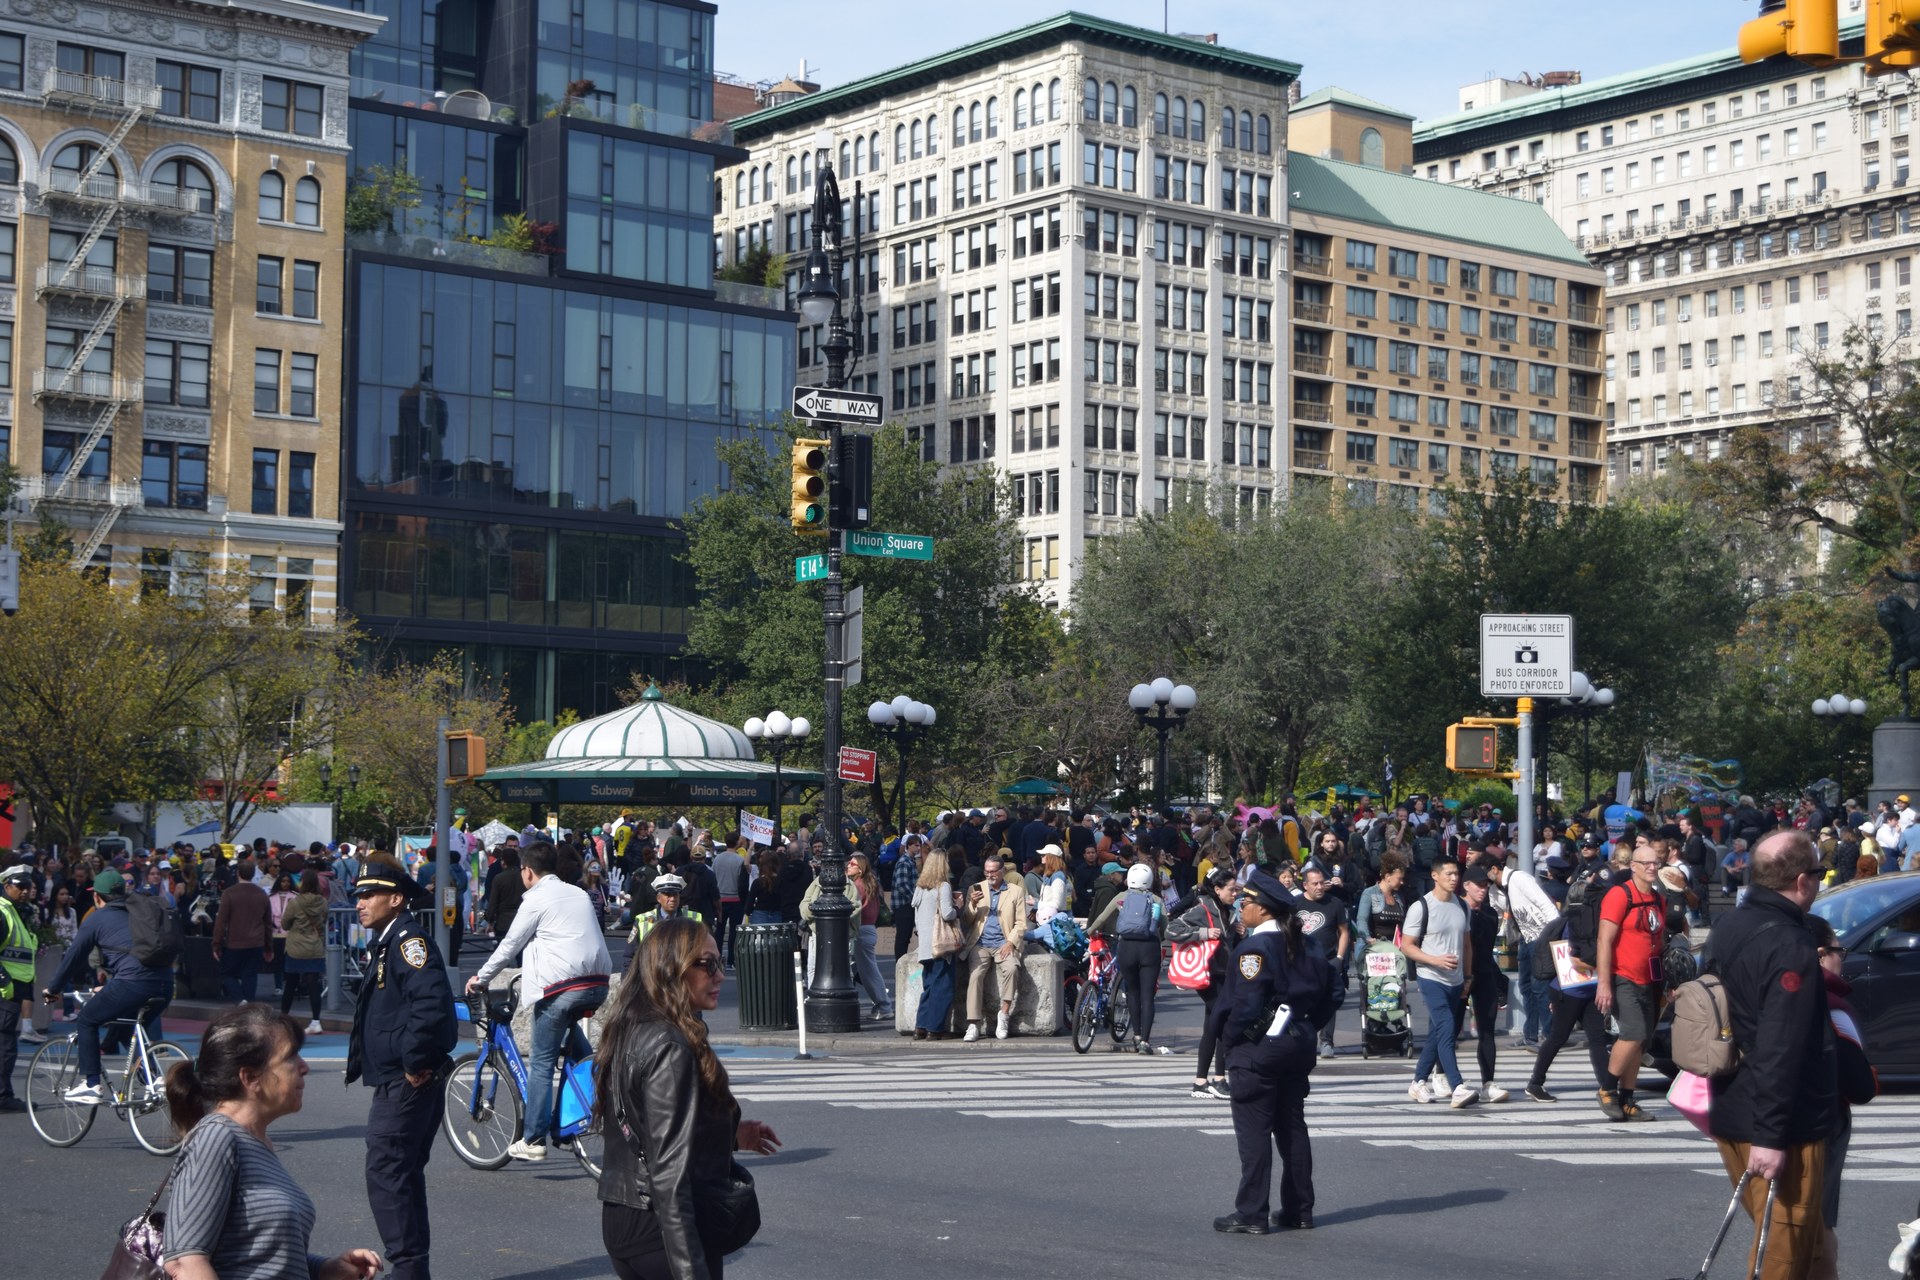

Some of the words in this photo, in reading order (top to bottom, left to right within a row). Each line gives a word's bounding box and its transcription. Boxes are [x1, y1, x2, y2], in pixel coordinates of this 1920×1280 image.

[805, 397, 832, 411] ONE
[847, 401, 875, 415] WAY
[853, 533, 883, 546] Union
[887, 536, 924, 550] Square
[801, 560, 806, 578] E
[808, 559, 817, 577] 14
[1489, 623, 1537, 632] APPROACHING
[1540, 624, 1564, 632] STREET
[1496, 668, 1512, 677] BUS
[1516, 668, 1558, 677] CORRIDOR
[1490, 681, 1517, 689] PHOTO
[1520, 681, 1564, 689] ENFORCED
[850, 751, 870, 760] STOPPING
[508, 786, 523, 796] Union
[524, 786, 543, 797] Square
[591, 784, 634, 797] Subway
[690, 784, 719, 796] Union
[722, 785, 758, 798] Square
[742, 811, 756, 822] STOP
[618, 829, 625, 841] 8
[750, 823, 774, 837] RACISM
